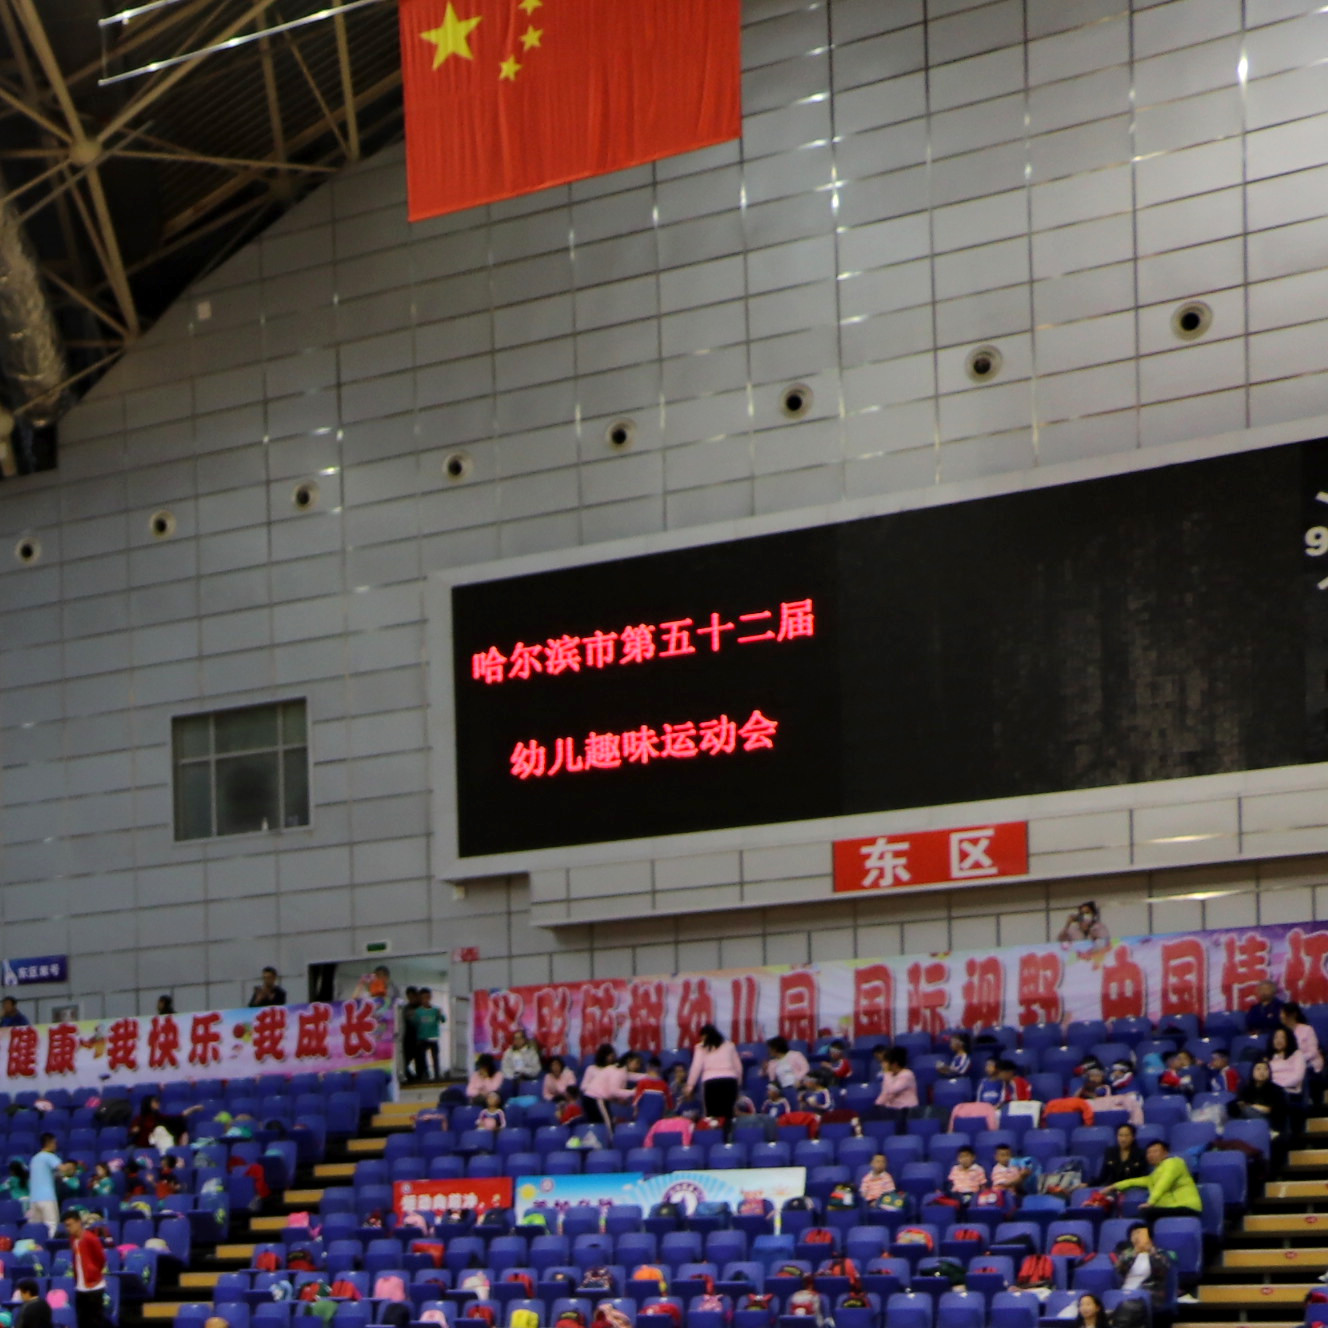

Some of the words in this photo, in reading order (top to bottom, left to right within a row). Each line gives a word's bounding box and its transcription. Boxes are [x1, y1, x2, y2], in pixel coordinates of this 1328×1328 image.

[471, 598, 815, 685] 哈尔滨市第五十二届
[510, 709, 778, 780] 幼儿趣味运动会
[859, 828, 999, 888] 东区
[107, 1009, 223, 1071] 我快乐
[252, 998, 381, 1064] 我成长
